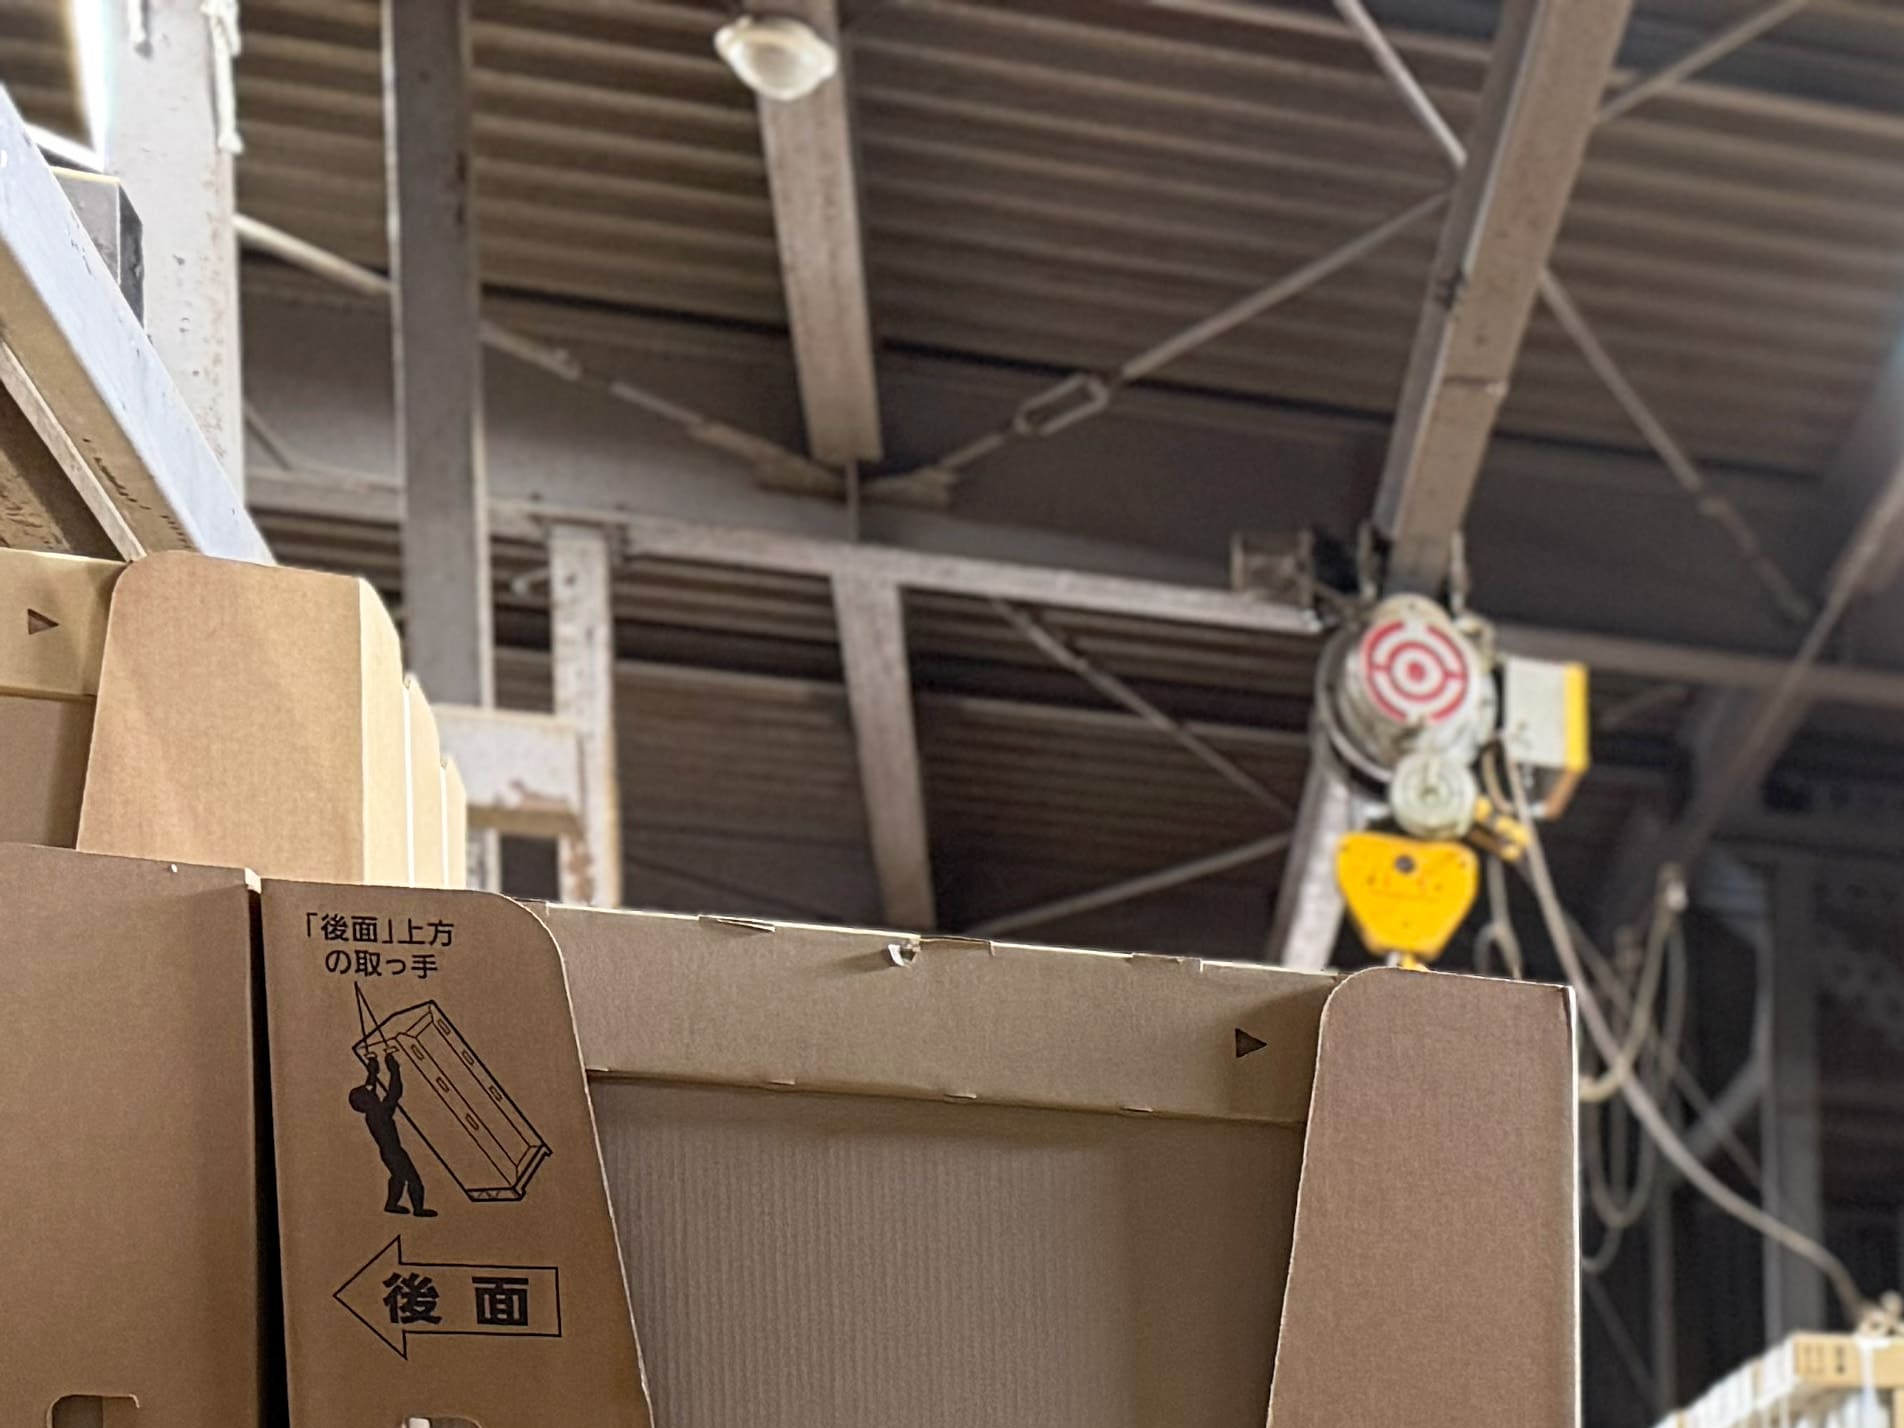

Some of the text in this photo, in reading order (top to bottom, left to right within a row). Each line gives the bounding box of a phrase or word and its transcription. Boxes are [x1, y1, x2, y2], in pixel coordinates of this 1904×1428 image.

[305, 913, 454, 947] 「後面」上方
[325, 950, 438, 979] の取っ手
